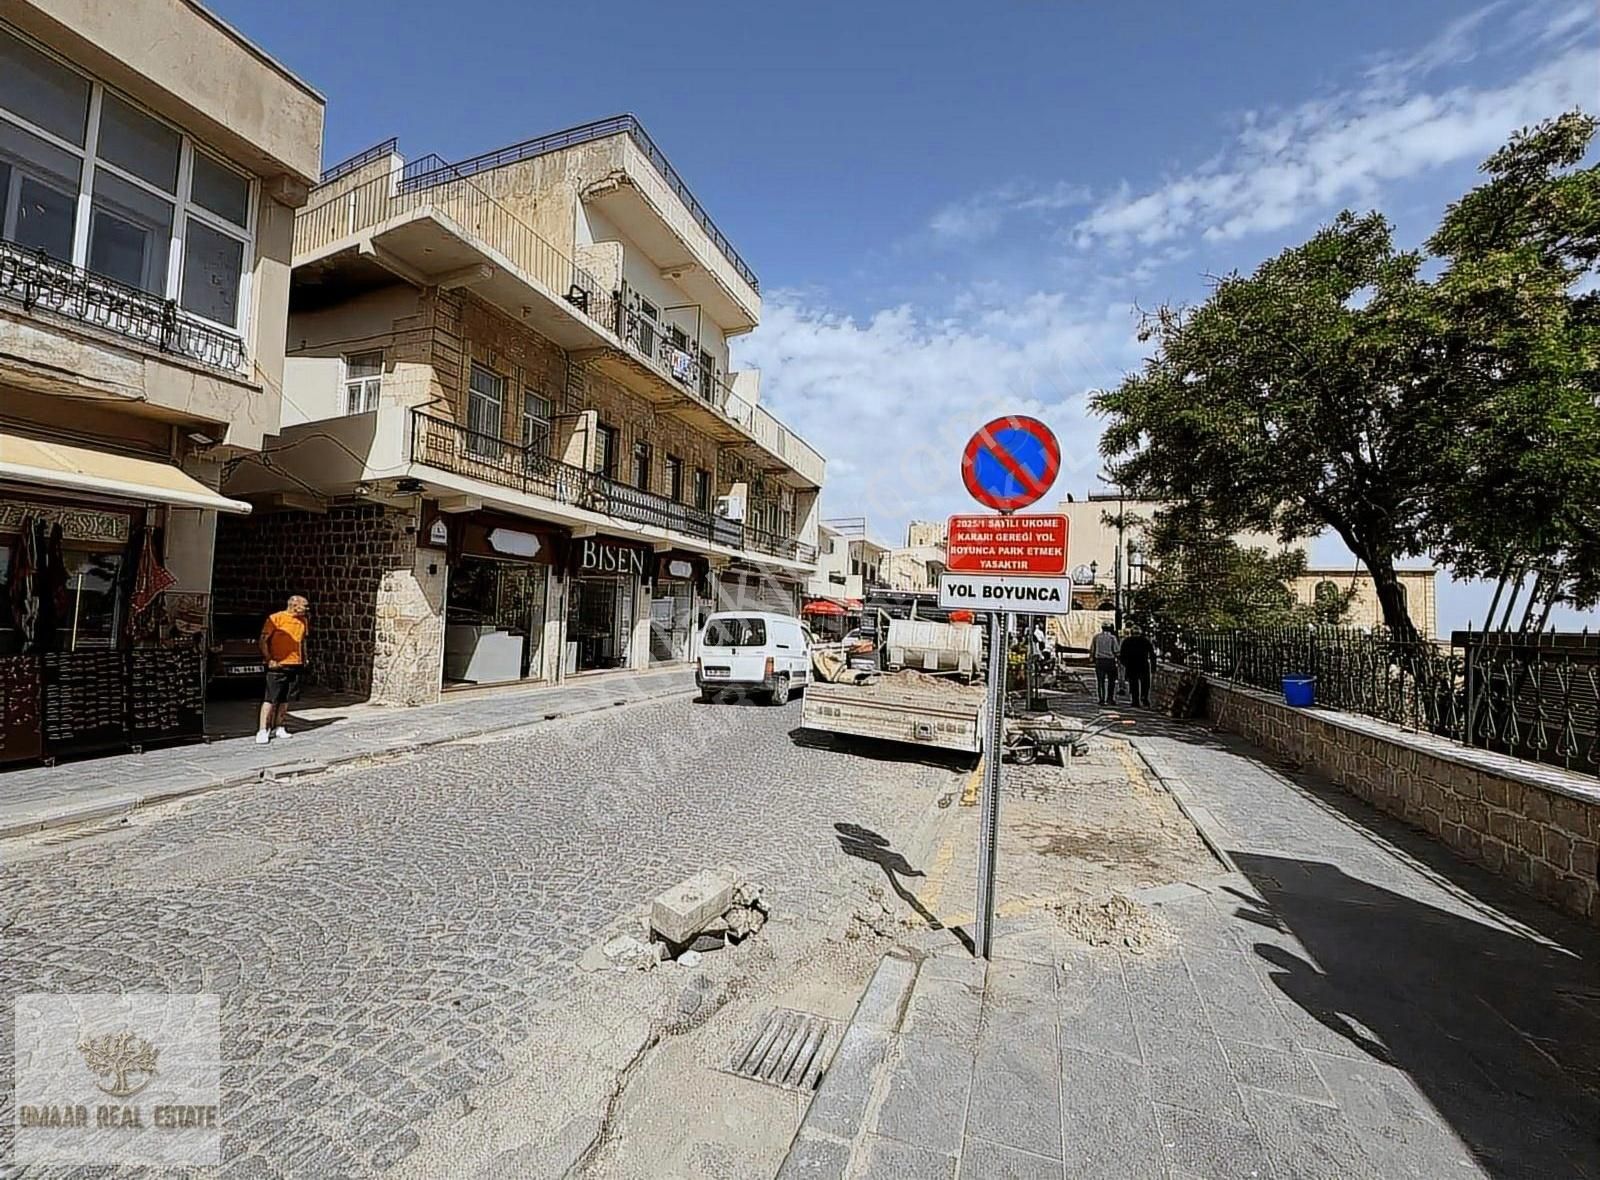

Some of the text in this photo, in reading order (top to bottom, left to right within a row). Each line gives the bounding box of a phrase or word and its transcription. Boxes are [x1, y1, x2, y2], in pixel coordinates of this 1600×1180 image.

[1022, 519, 1059, 528] UKOME
[957, 533, 993, 541] KARARI
[1035, 533, 1056, 542] YOL
[950, 546, 1063, 556] BOYUNCA PARK ETMEK
[582, 540, 644, 575] BISEN
[979, 560, 1029, 569] YASAKTIR
[947, 584, 1061, 602] YOL BOYUNCA
